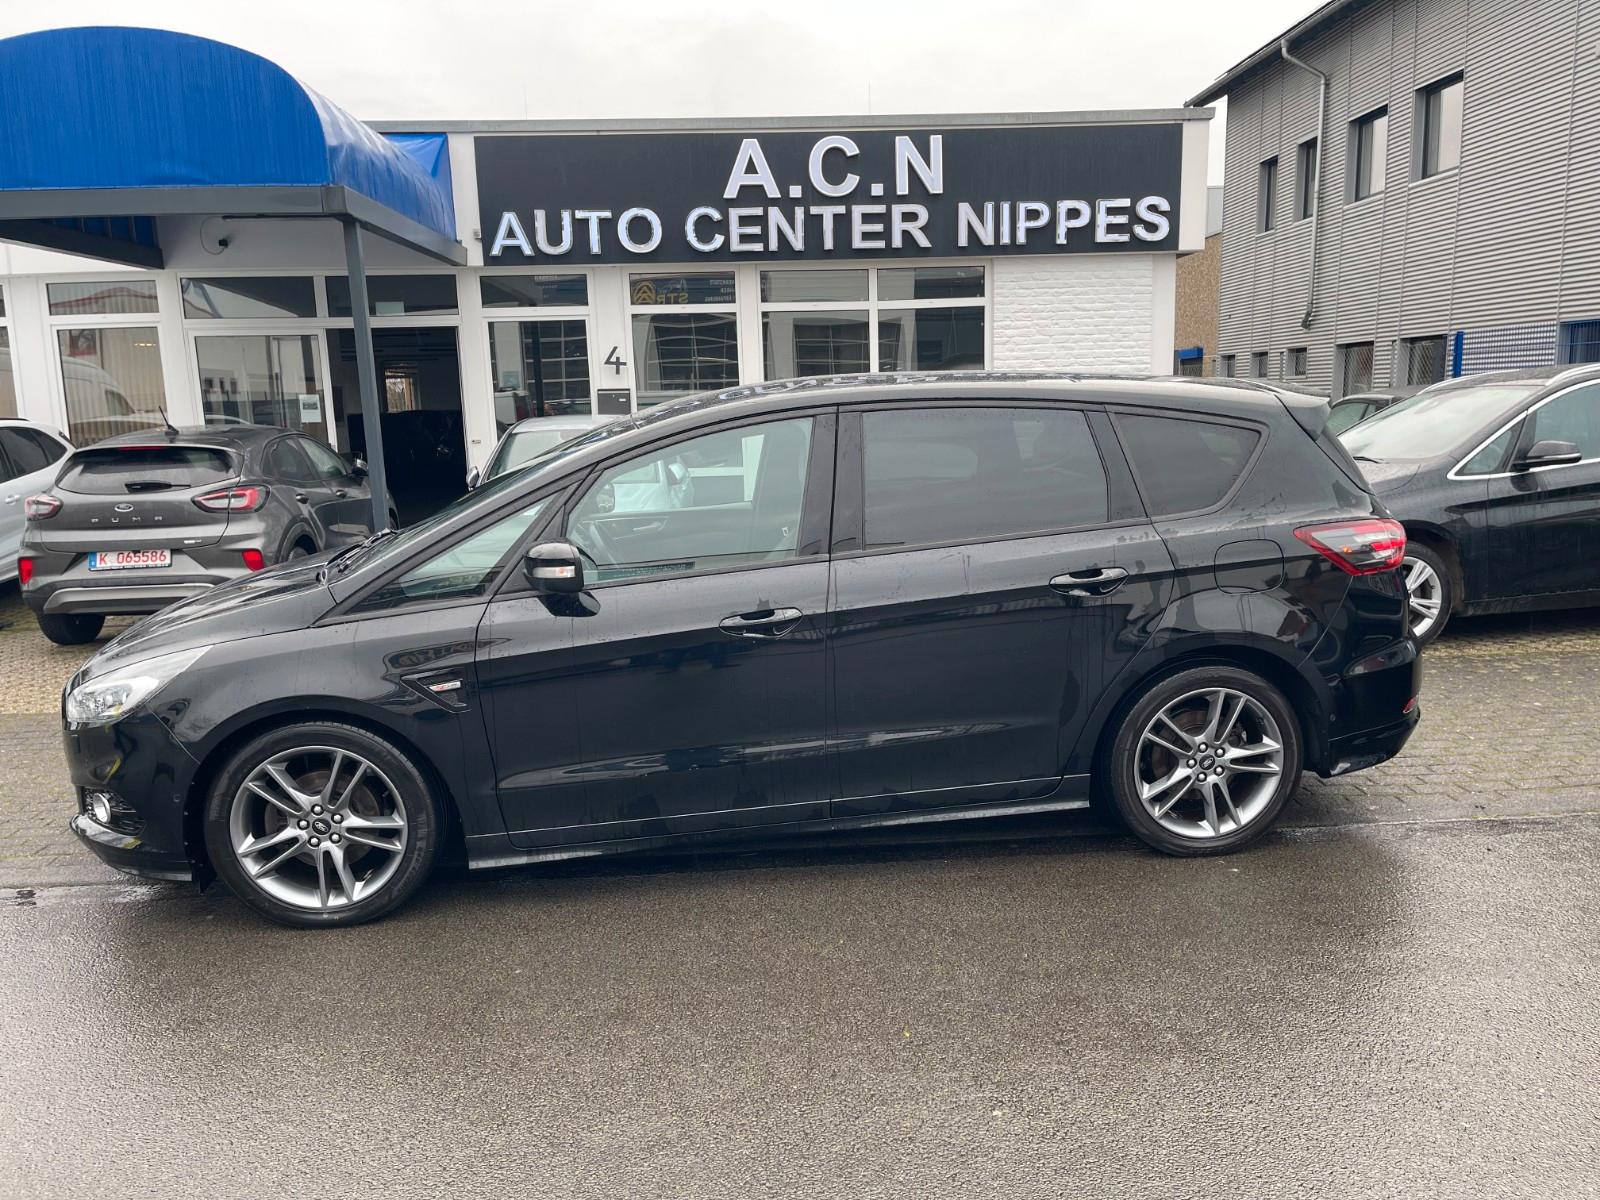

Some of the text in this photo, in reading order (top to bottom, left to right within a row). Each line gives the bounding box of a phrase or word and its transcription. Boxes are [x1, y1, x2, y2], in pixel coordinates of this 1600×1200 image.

[723, 133, 944, 200] A.C.N
[489, 195, 1172, 257] AUTO CENTER NIPPES
[603, 345, 627, 376] 4
[99, 550, 167, 566] K 065586
